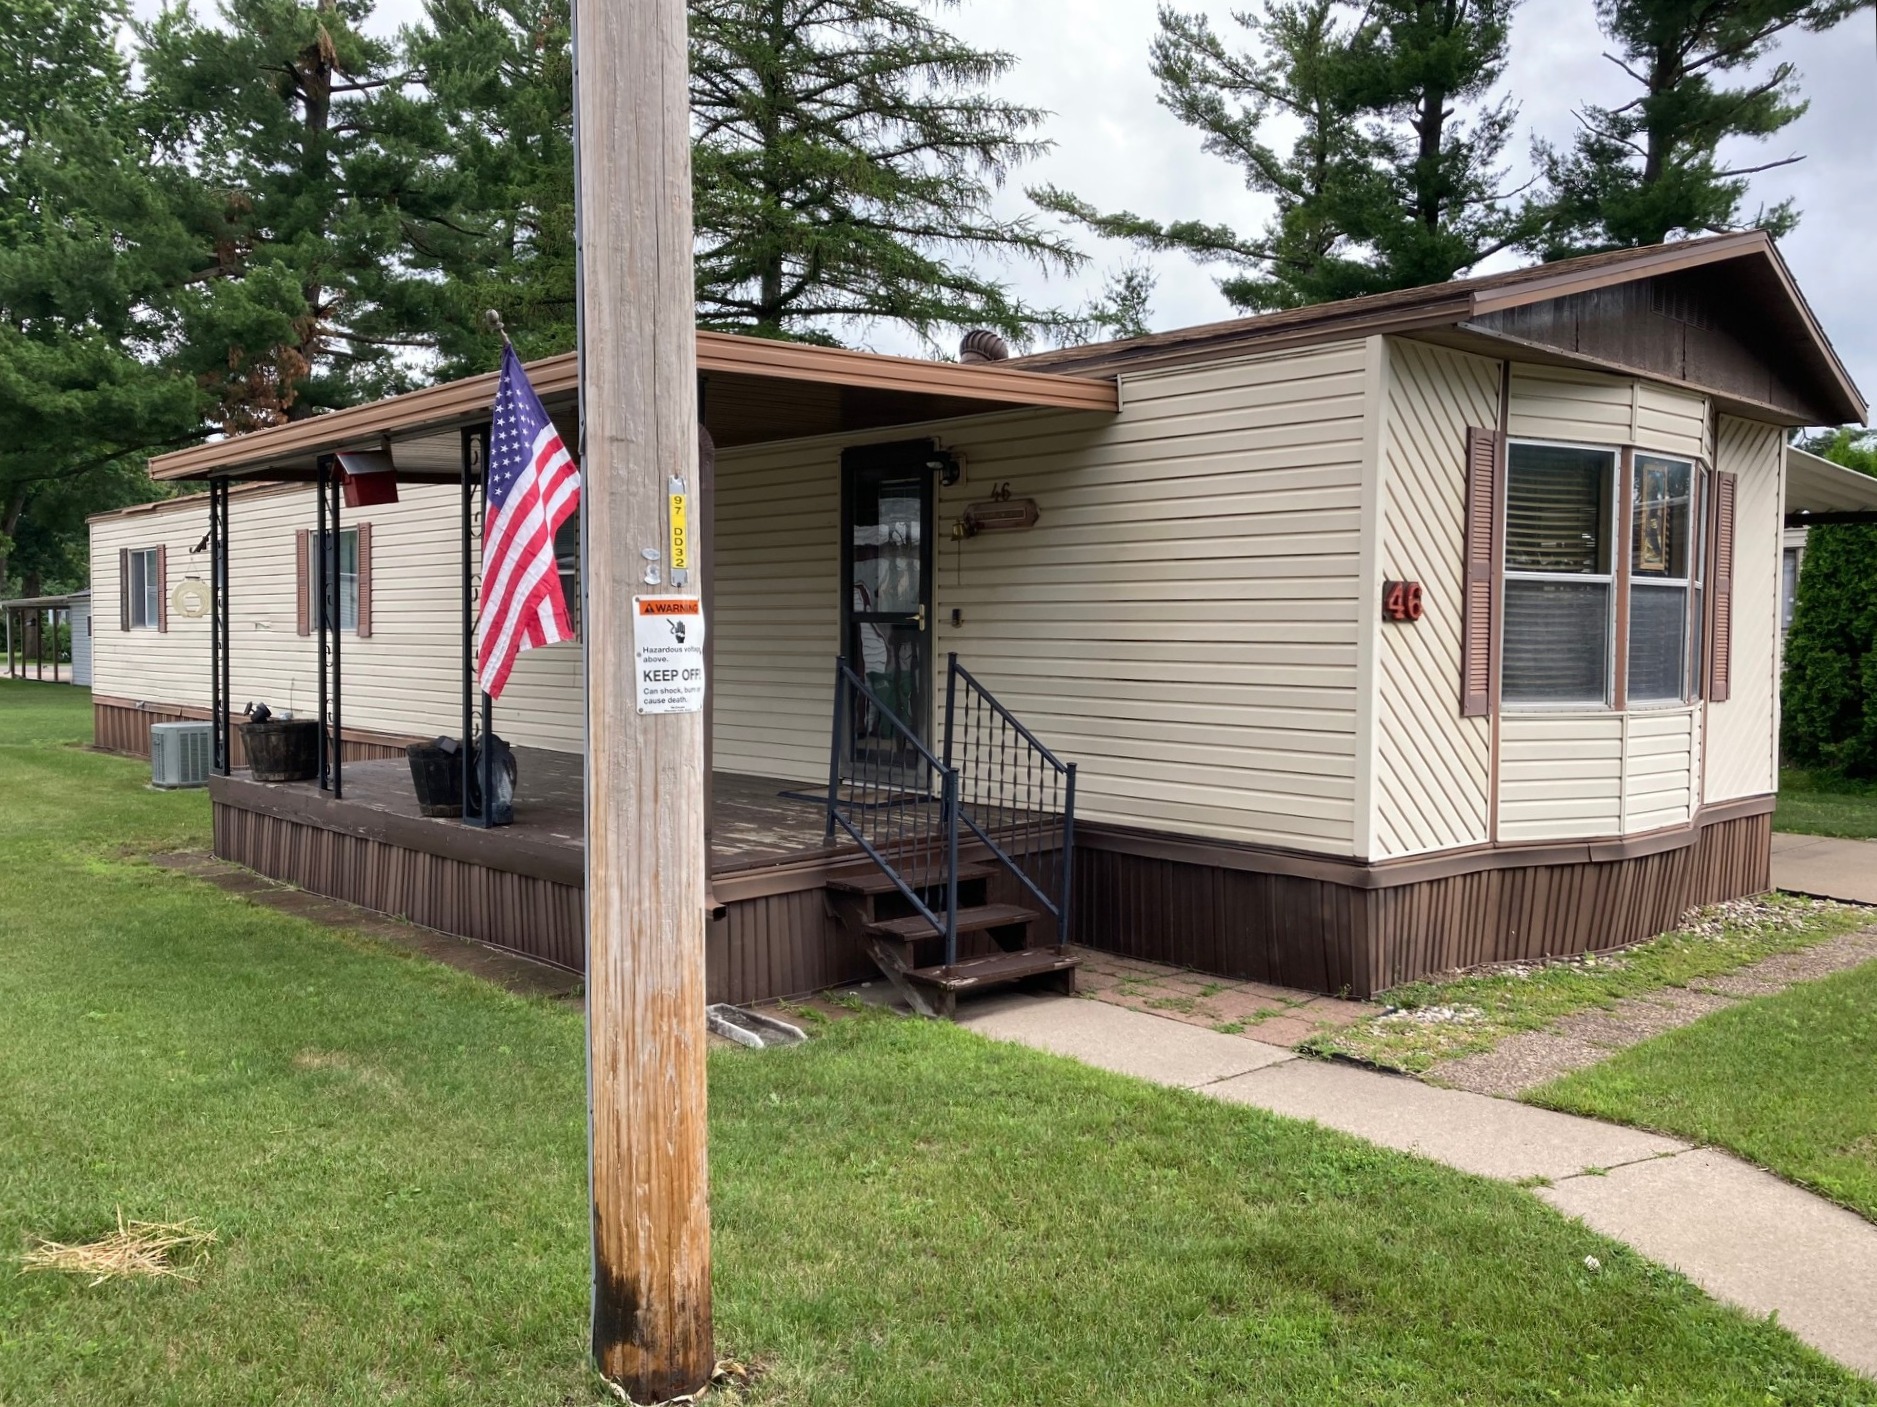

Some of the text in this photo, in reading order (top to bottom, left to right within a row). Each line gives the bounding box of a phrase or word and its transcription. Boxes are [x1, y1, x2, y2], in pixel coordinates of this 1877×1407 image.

[991, 482, 1012, 501] 46
[673, 495, 684, 568] 97 DD32
[1385, 582, 1422, 620] 46
[655, 603, 698, 613] WARNING
[642, 646, 682, 654] Hazardous
[643, 669, 679, 682] KEEP
[643, 687, 659, 695] Can
[643, 696, 687, 705] cause death.
